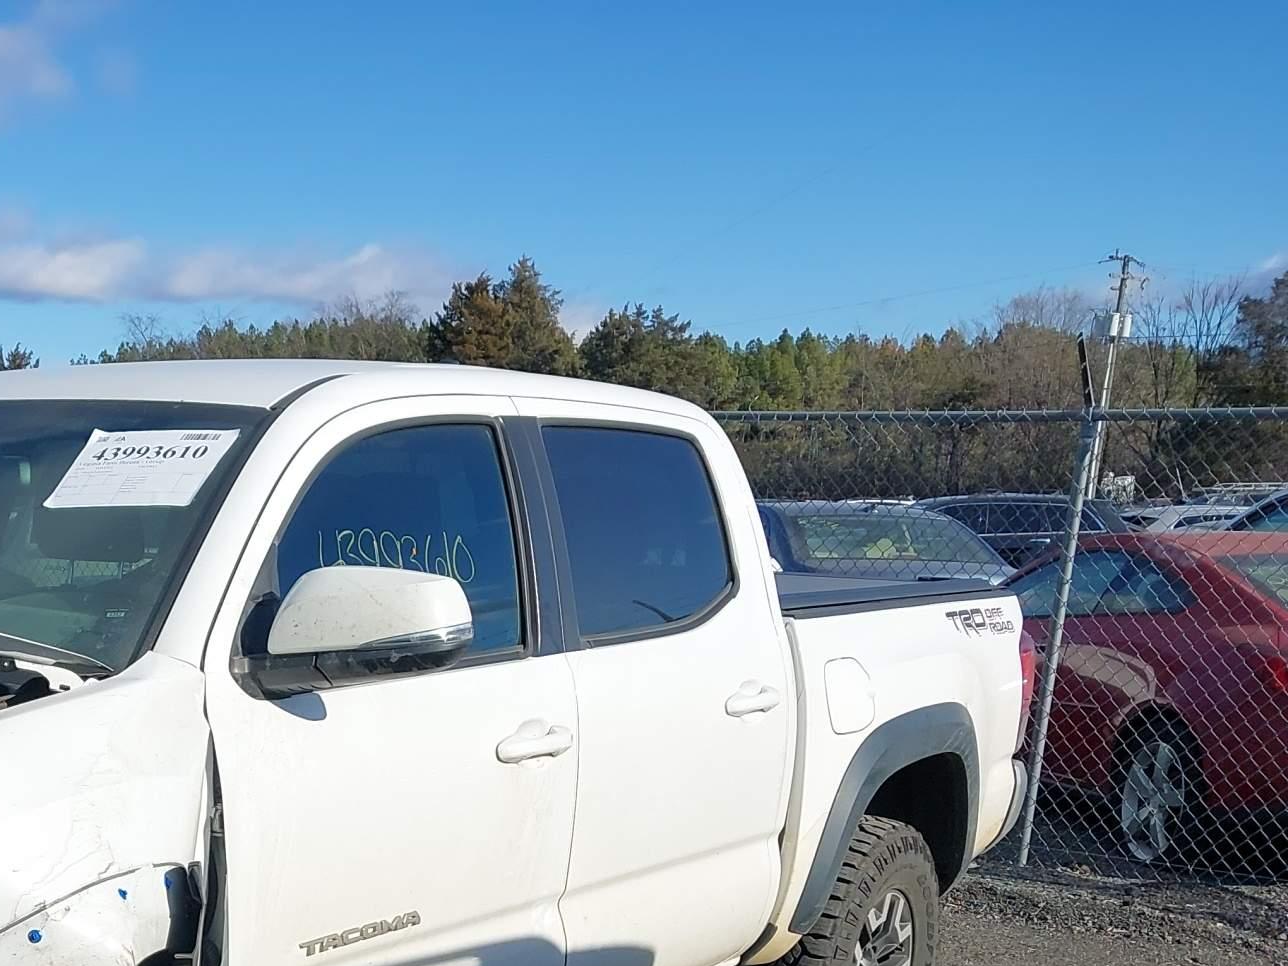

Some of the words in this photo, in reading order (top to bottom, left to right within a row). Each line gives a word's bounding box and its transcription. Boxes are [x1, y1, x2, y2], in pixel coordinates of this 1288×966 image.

[91, 444, 210, 462] 43993610
[945, 608, 986, 638] TRD
[984, 607, 1004, 619] OFF
[989, 620, 1015, 634] ROAD
[298, 910, 421, 957] TACOMA
